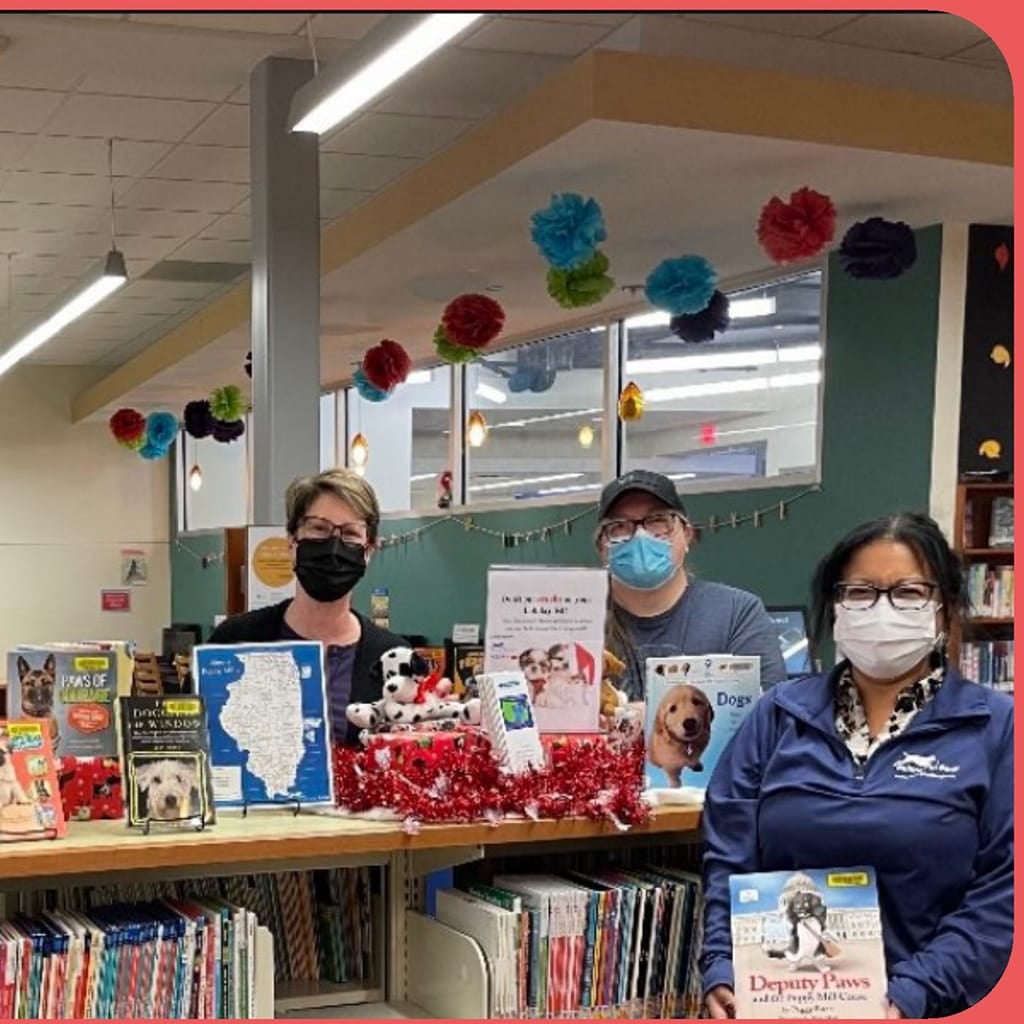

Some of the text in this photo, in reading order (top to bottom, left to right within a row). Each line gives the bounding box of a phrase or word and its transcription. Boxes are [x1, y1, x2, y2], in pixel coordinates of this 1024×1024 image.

[717, 691, 753, 708] Dogs
[749, 972, 871, 995] Deputy Paws
